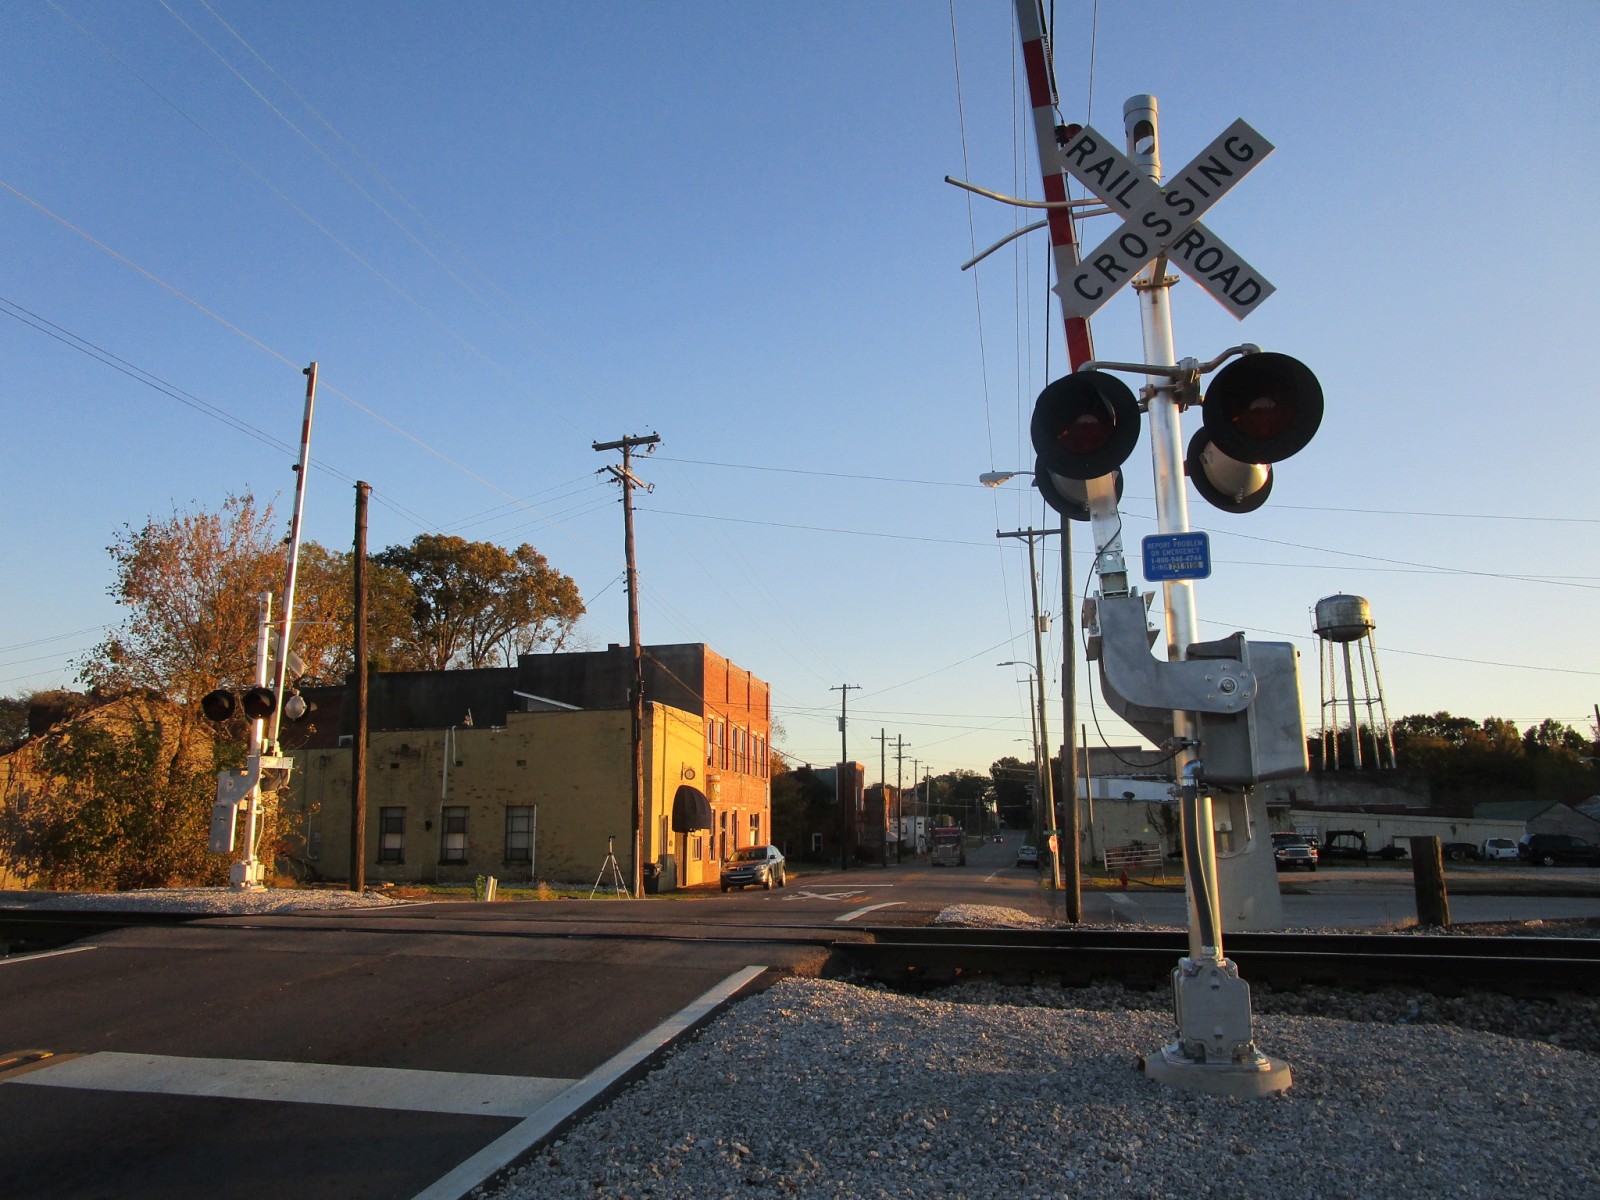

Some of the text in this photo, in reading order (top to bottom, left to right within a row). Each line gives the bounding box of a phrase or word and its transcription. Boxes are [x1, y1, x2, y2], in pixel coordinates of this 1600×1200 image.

[1065, 134, 1140, 210] RAIL
[1073, 136, 1254, 301] CROSSING
[1171, 228, 1262, 306] ROAD
[1162, 547, 1200, 556] EMERGENCY
[1173, 540, 1203, 548] PROBLEM
